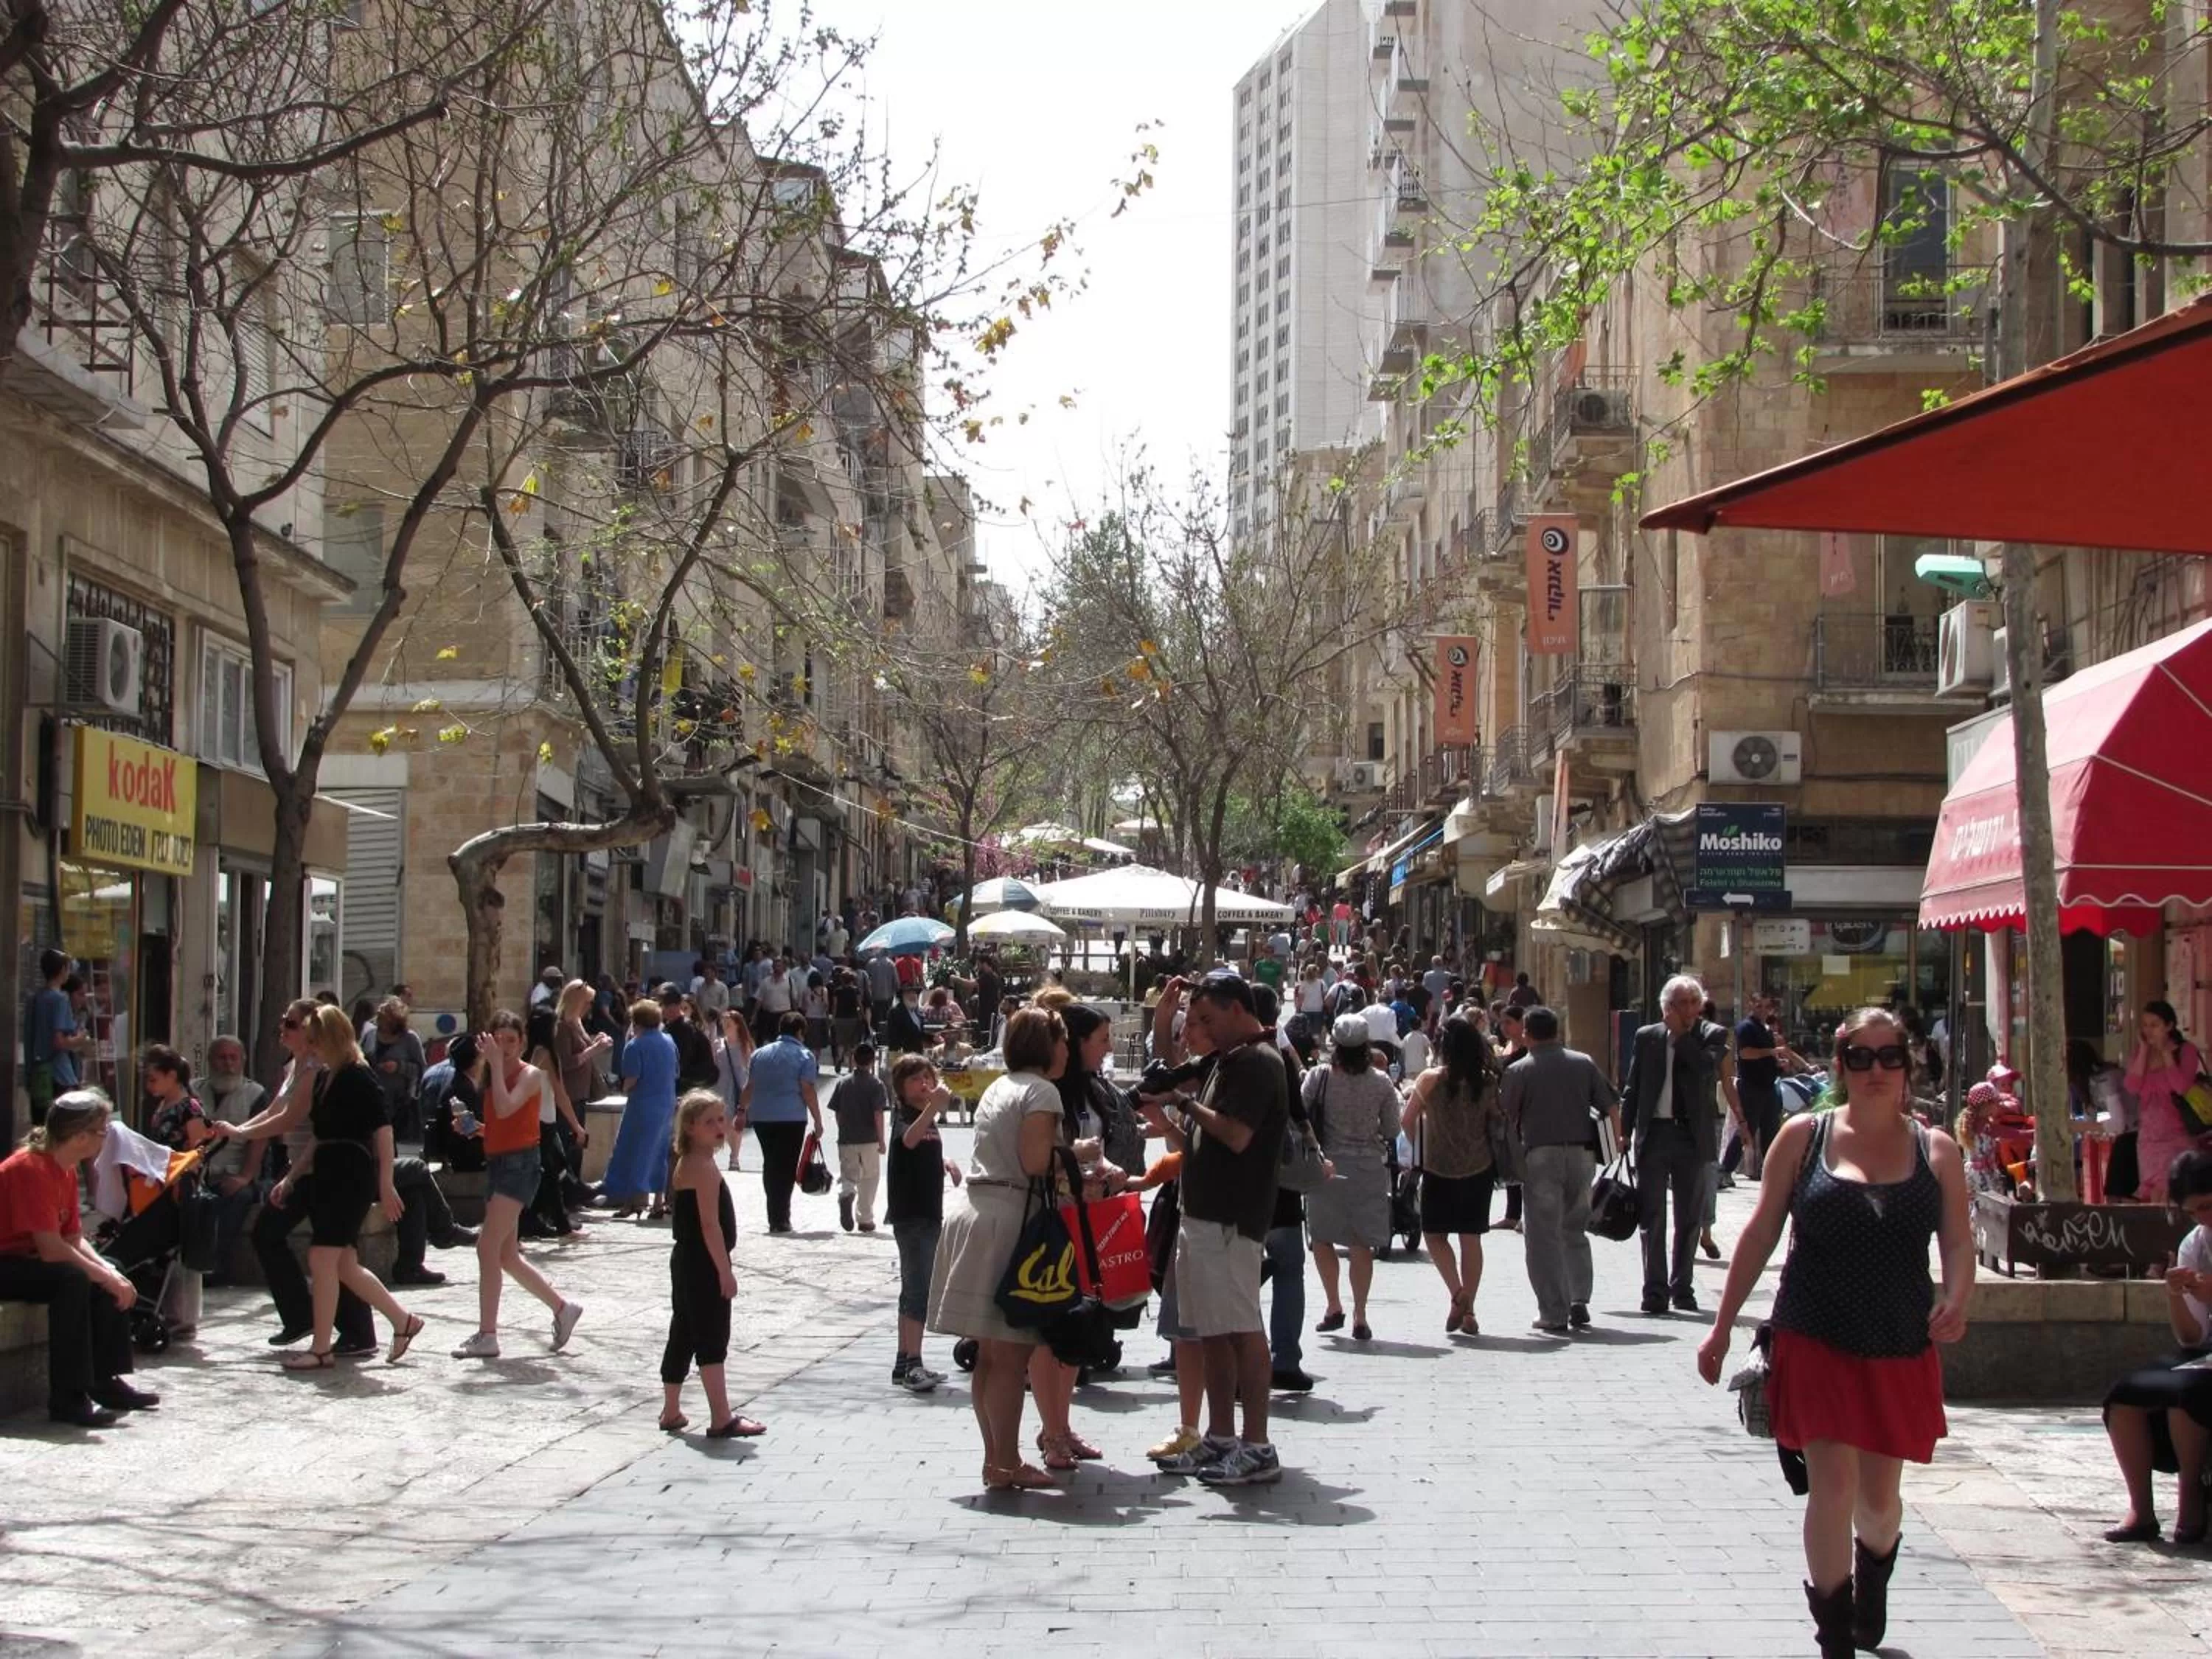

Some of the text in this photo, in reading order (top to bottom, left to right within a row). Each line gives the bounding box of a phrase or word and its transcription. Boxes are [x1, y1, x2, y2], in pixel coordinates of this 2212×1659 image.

[1547, 560, 1565, 621] אנקורי
[86, 813, 147, 860] PHOTO EDEN
[1700, 832, 1782, 851] Moshiko
[1217, 909, 1245, 919] COFFEE
[1255, 910, 1284, 919] BAKERY
[1008, 1241, 1076, 1303] Cal
[1098, 1250, 1144, 1270] ASTRO
